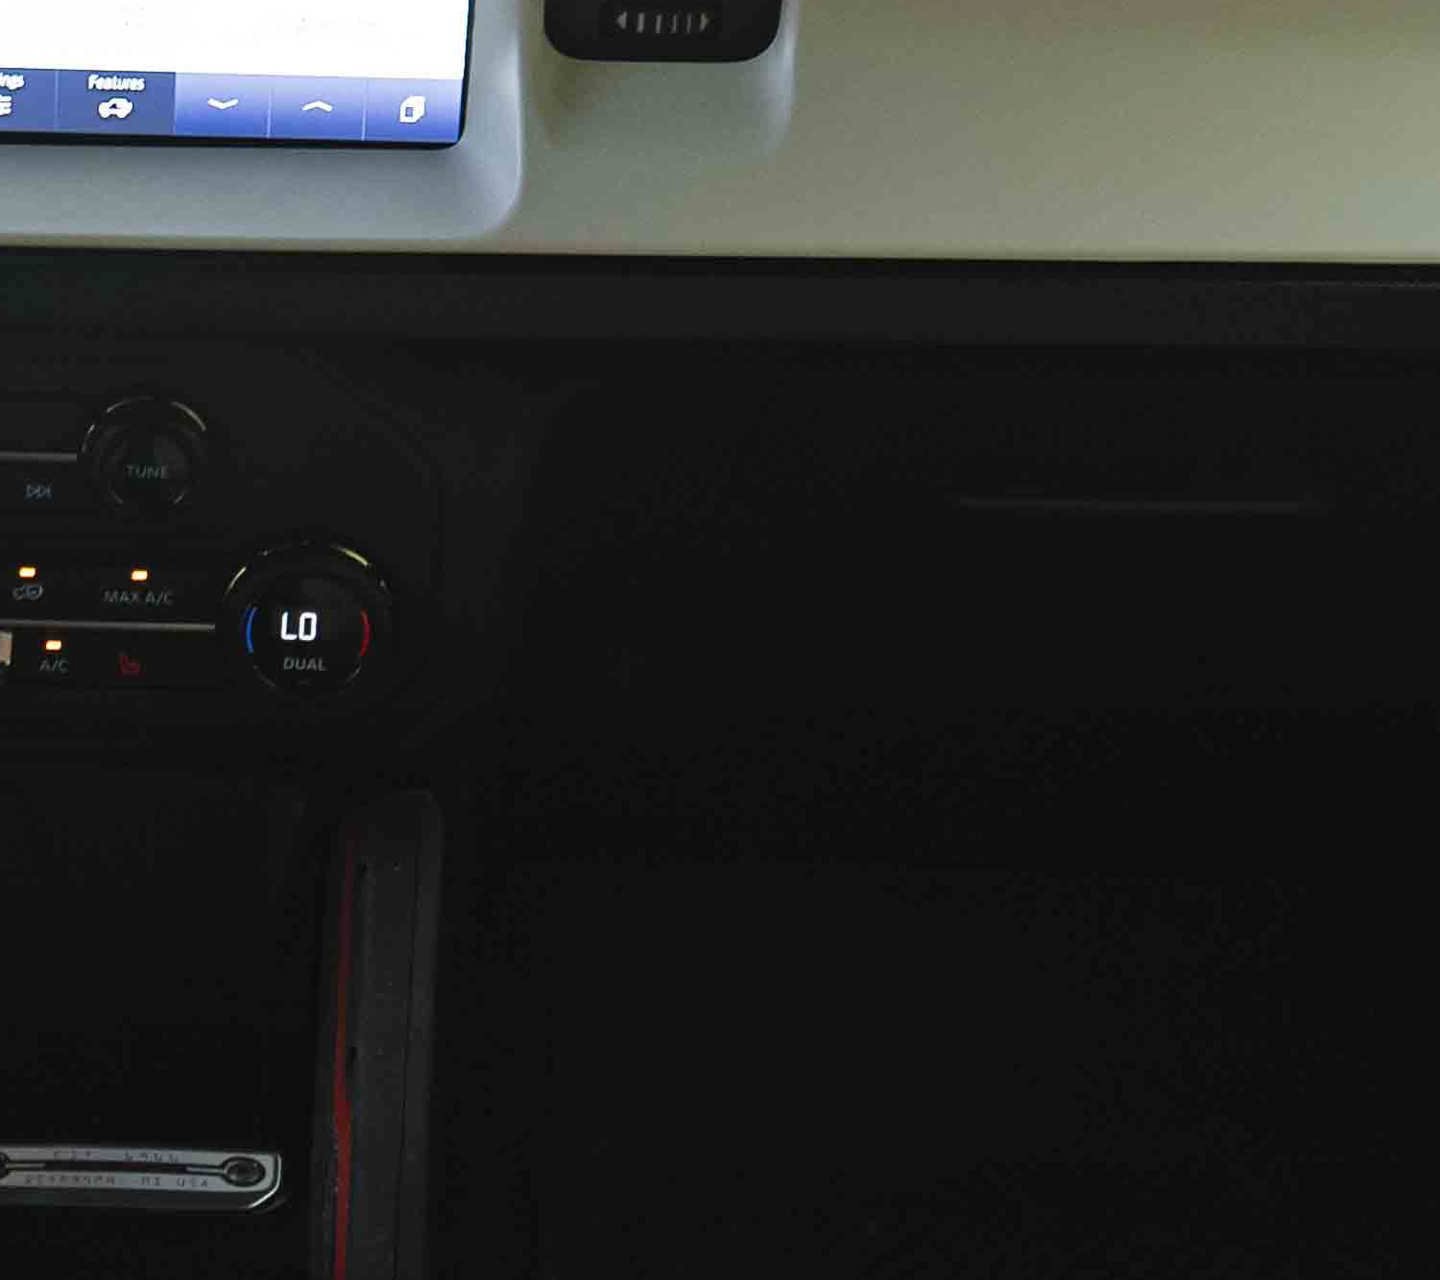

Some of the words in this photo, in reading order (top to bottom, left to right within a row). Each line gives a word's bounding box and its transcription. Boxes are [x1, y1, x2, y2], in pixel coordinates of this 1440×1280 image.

[87, 75, 145, 93] Features
[124, 464, 169, 479] TUNE
[103, 588, 138, 604] MAX
[141, 590, 176, 605] A/C
[280, 611, 317, 641] LO
[38, 657, 69, 674] A/C
[282, 655, 326, 671] DUAL
